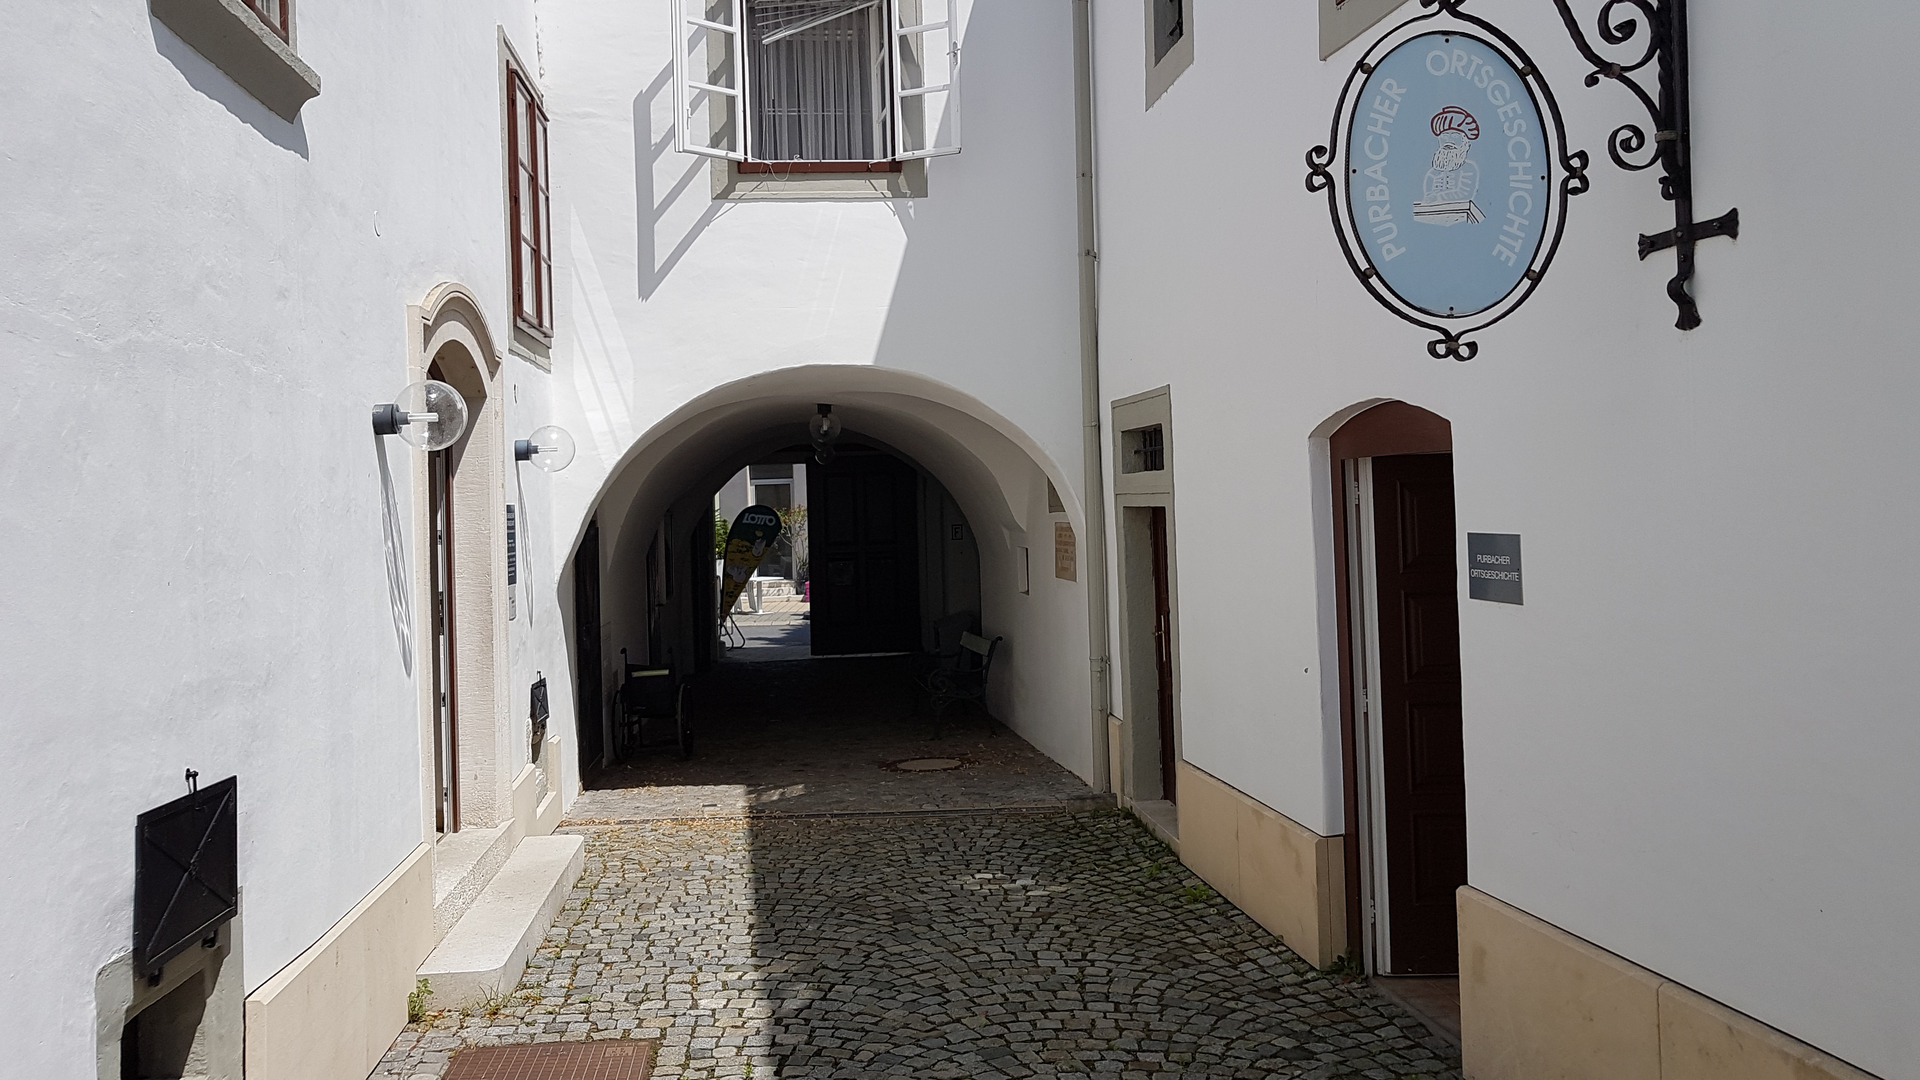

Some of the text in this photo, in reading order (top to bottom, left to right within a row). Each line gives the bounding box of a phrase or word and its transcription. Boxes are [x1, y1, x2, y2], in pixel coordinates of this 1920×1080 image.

[1426, 49, 1533, 267] ORTSGESCHICHTE
[1363, 78, 1407, 262] PURBACHER
[742, 513, 776, 526] LOTTO
[1476, 554, 1510, 565] PURBACHER
[1470, 569, 1519, 581] ORTSGESCHICHTE
